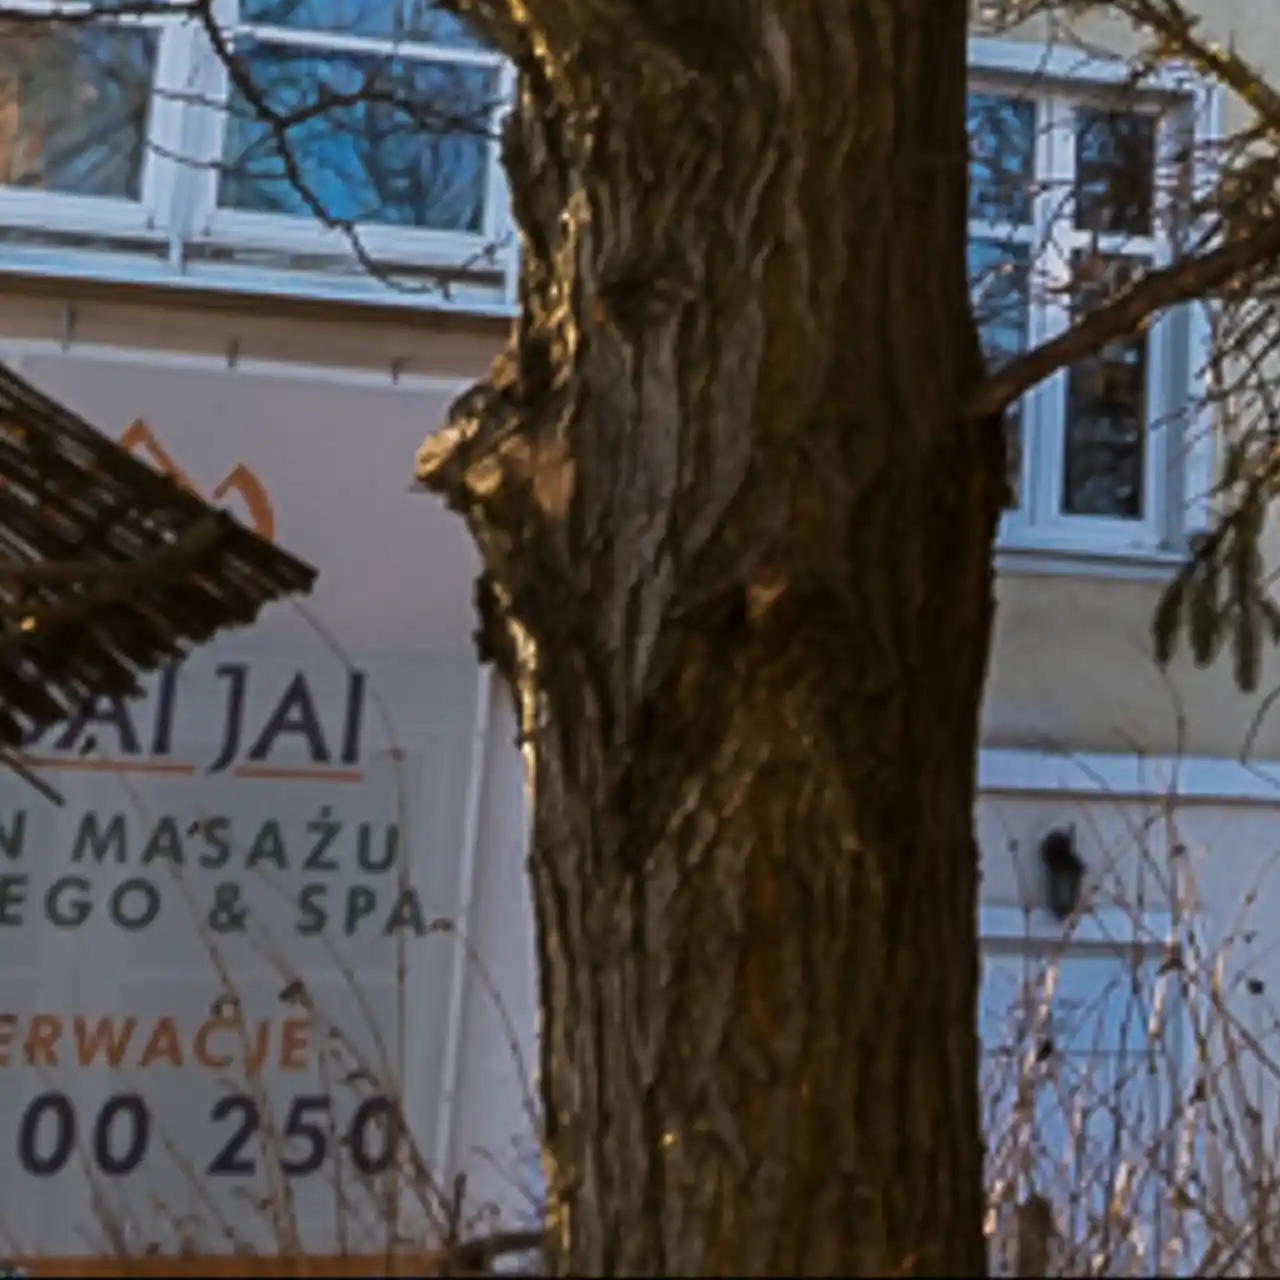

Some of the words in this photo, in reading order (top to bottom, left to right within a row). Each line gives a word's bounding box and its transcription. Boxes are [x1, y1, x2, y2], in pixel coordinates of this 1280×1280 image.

[206, 662, 368, 774] JAI
[71, 805, 400, 874] MASAŻU
[208, 881, 250, 933] &
[295, 884, 427, 937] SPA
[18, 1090, 151, 1177] 00
[206, 1091, 402, 1177] 250
